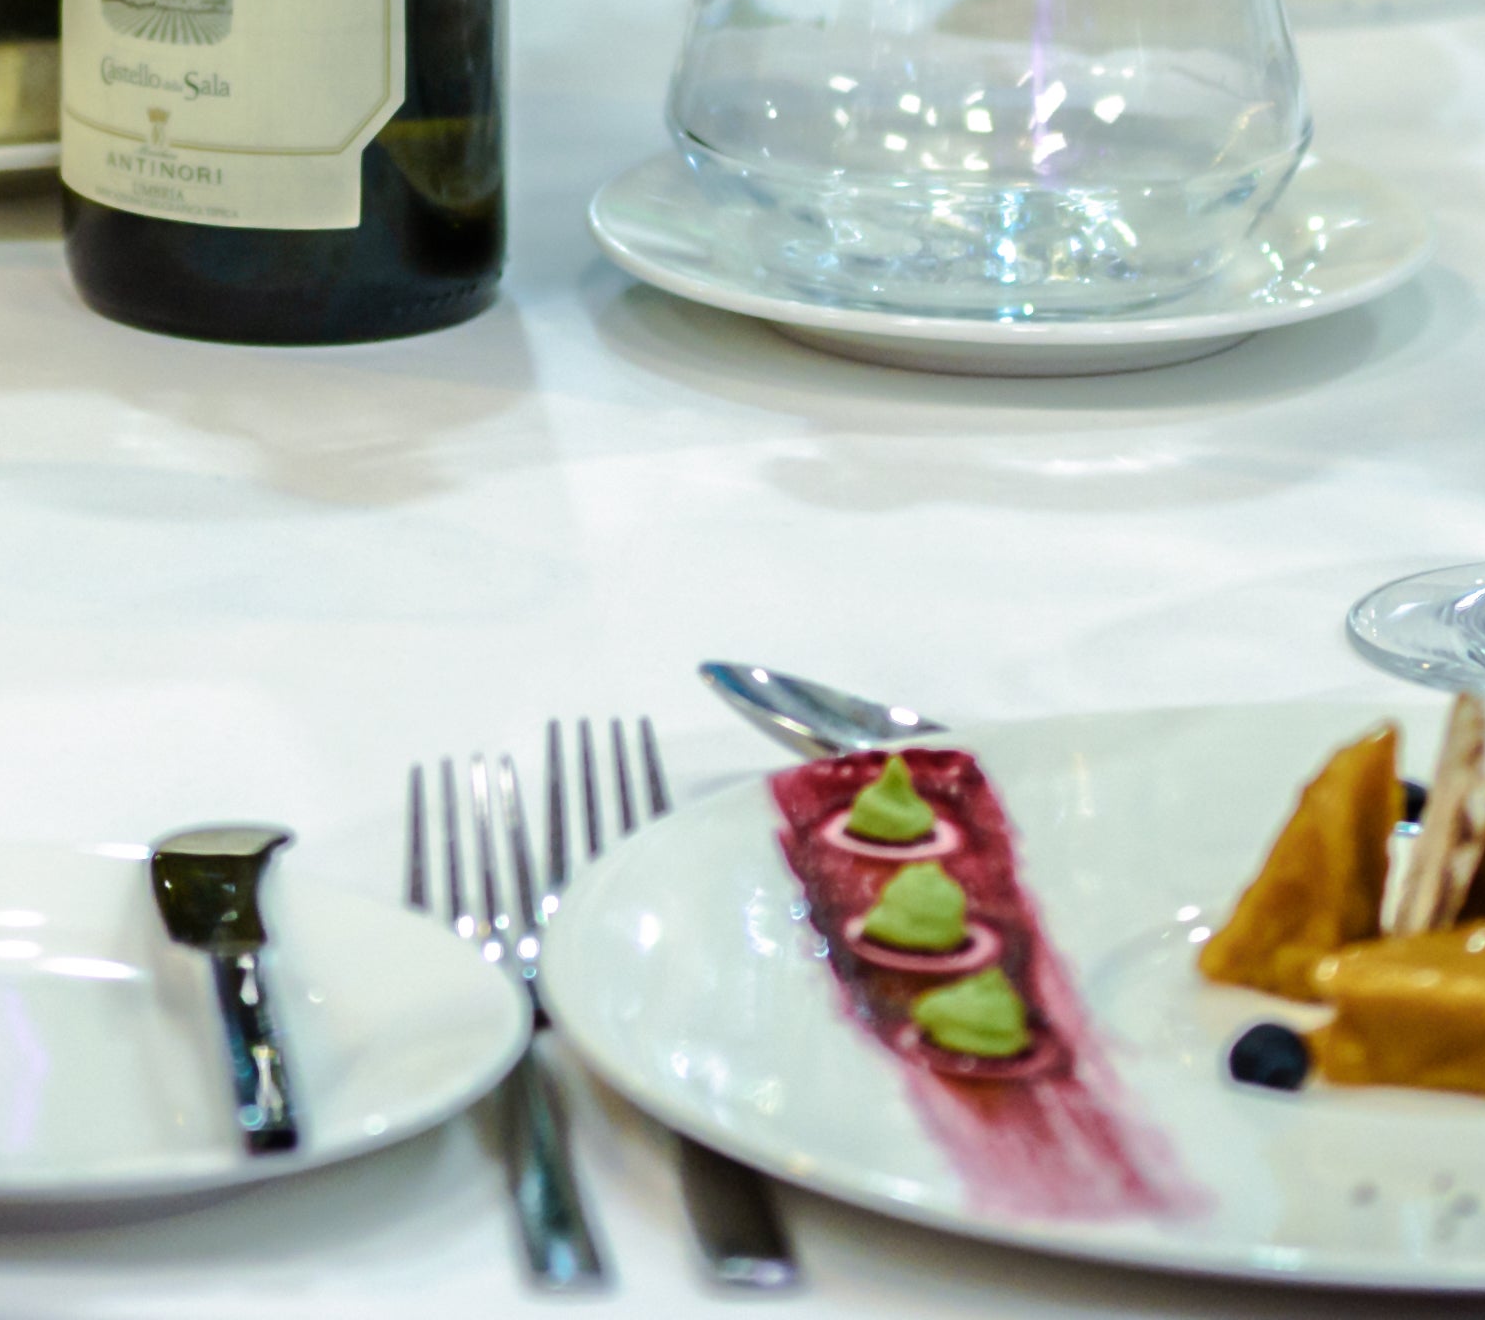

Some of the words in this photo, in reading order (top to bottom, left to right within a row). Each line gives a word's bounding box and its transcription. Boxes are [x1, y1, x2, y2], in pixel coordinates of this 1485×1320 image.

[101, 56, 162, 88] Castello
[183, 71, 231, 101] Sala
[106, 151, 223, 185] ANTINORI
